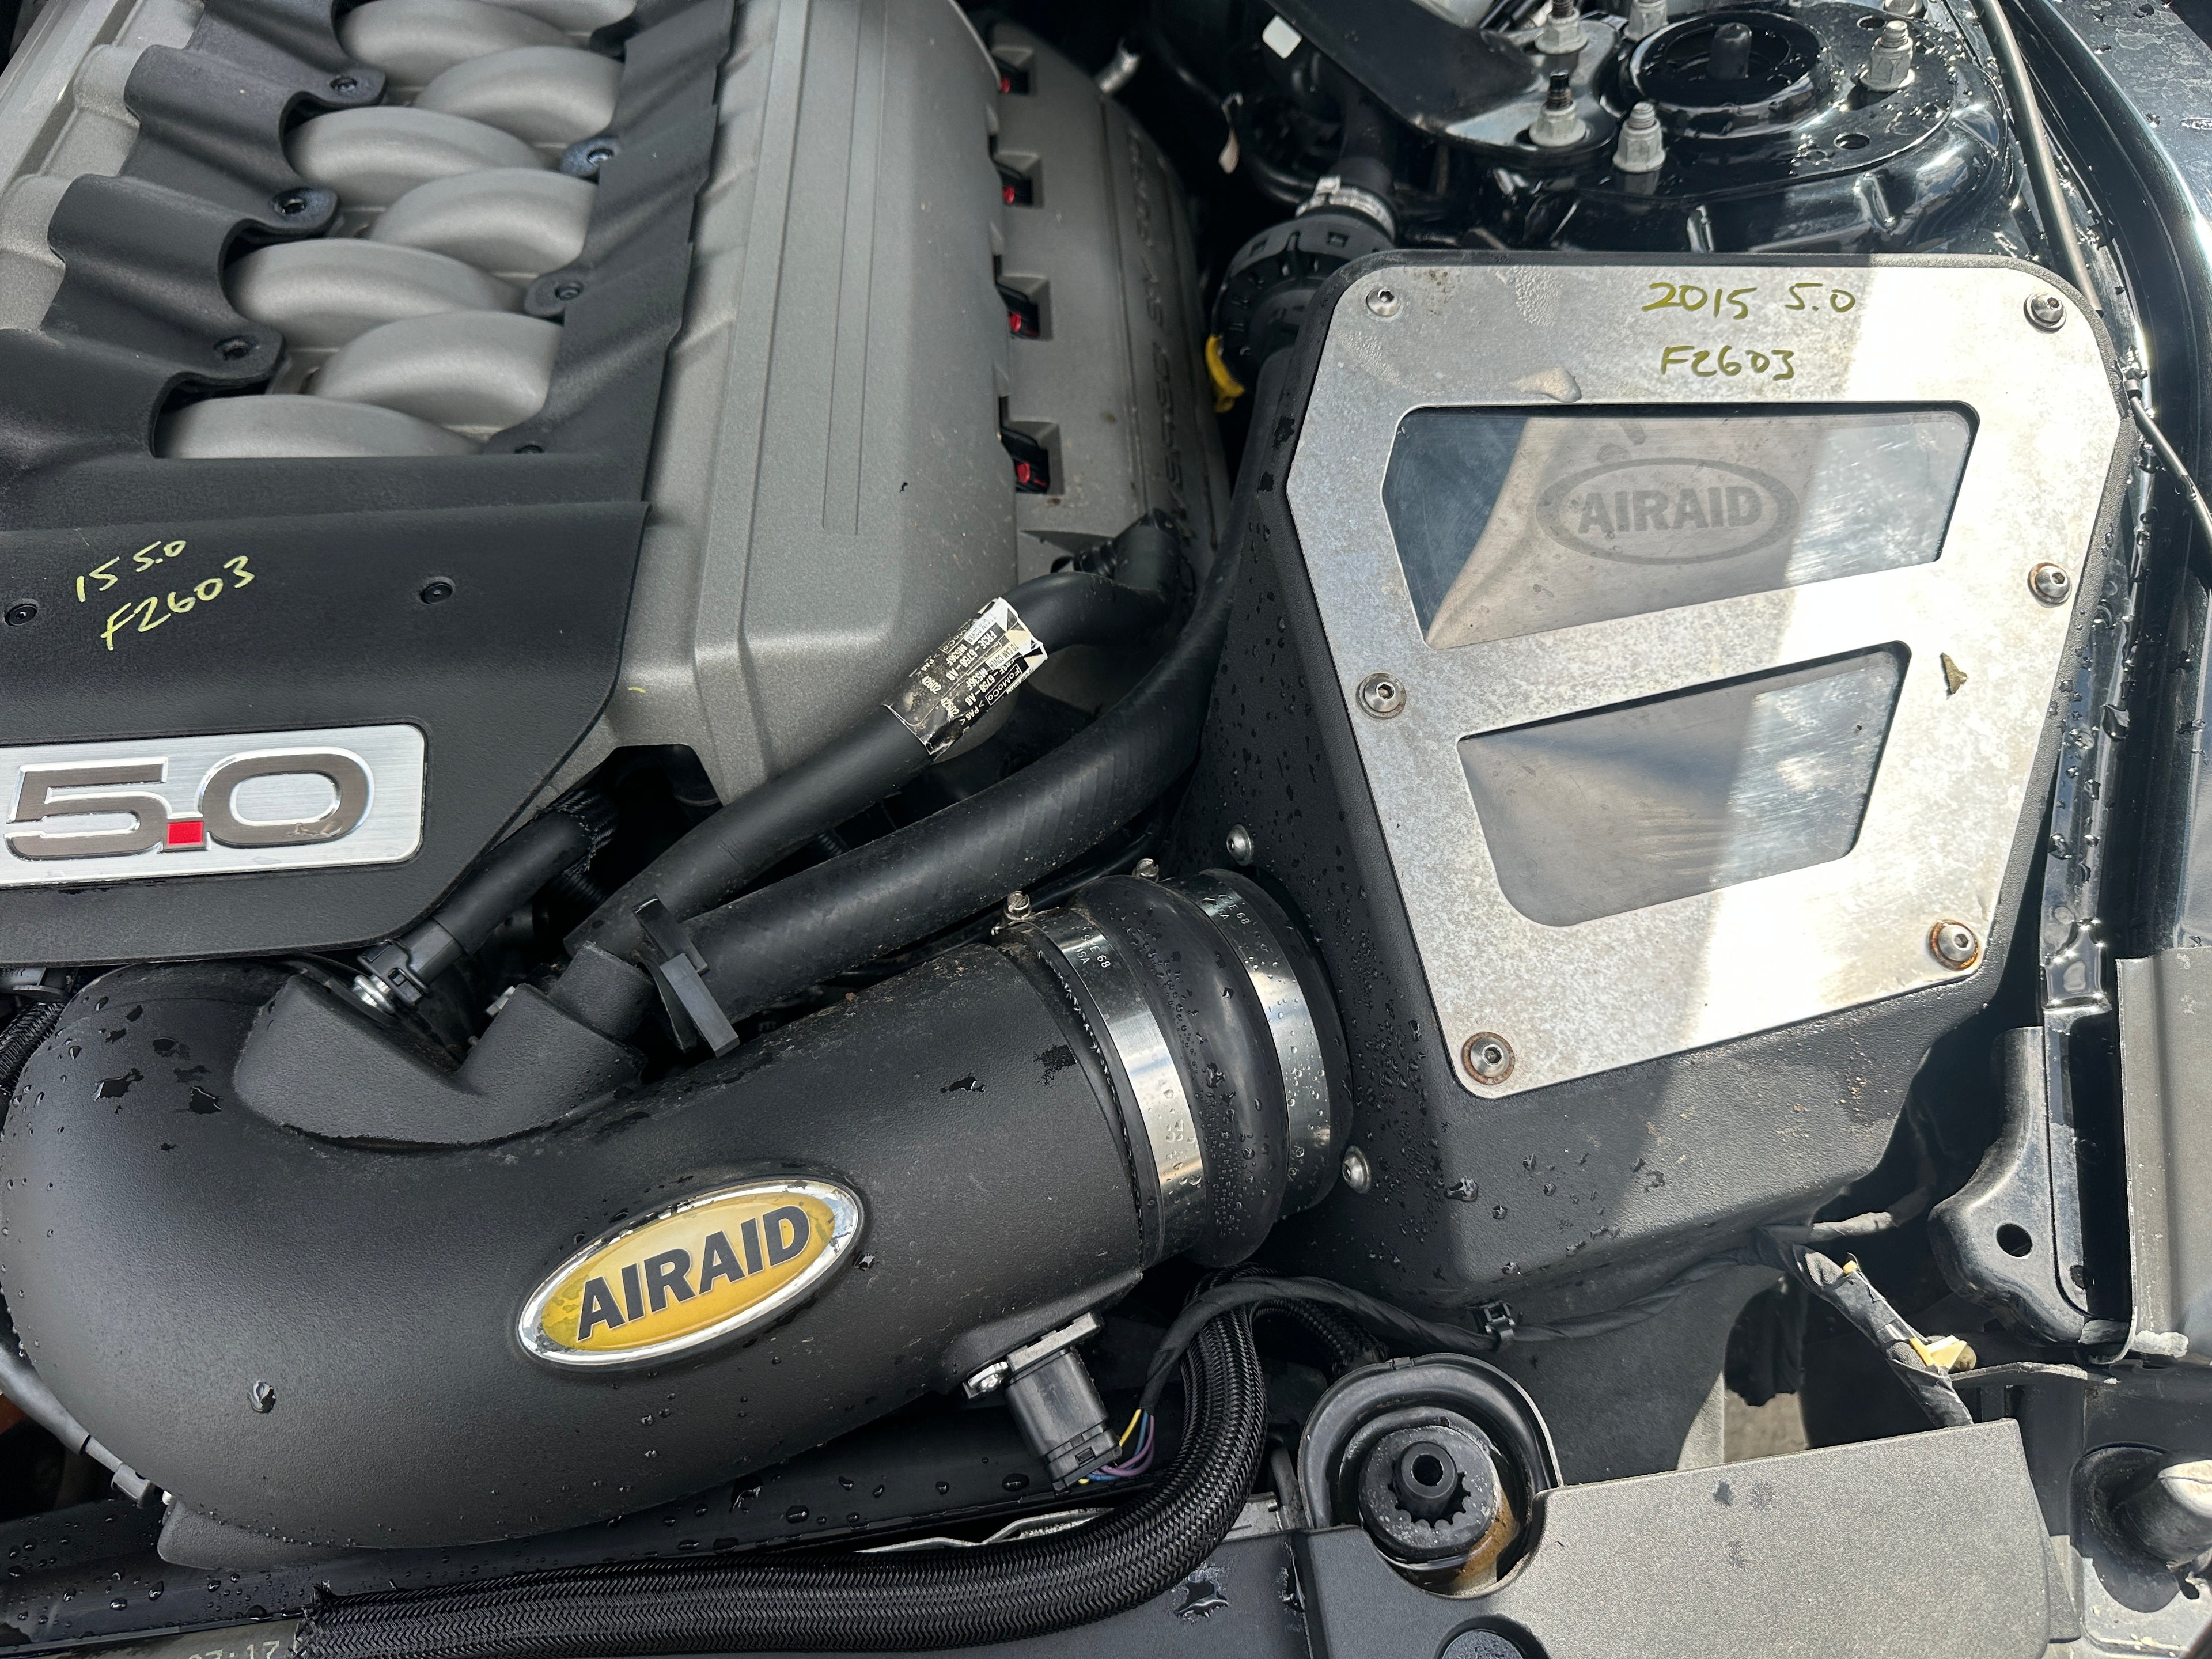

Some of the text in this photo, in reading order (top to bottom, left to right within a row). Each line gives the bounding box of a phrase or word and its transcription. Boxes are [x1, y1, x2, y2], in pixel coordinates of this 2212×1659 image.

[1641, 282, 1856, 320] 2015 5.0
[1661, 345, 1794, 381] F2603
[1578, 486, 1762, 534] AIRAID
[76, 540, 187, 603] 15 5.0
[101, 555, 255, 651] F2603
[965, 627, 982, 642] COVER
[1010, 642, 1019, 652] TO
[946, 643, 968, 666] M536F
[988, 654, 1004, 669] COVER
[1001, 647, 1013, 658] CAM
[965, 666, 988, 691] M536F
[987, 666, 1020, 701] FoMoCo
[3, 746, 376, 862] 5.0
[1236, 912, 1250, 925] 68
[1097, 955, 1111, 968] 68
[577, 1205, 811, 1343] AIRAID
